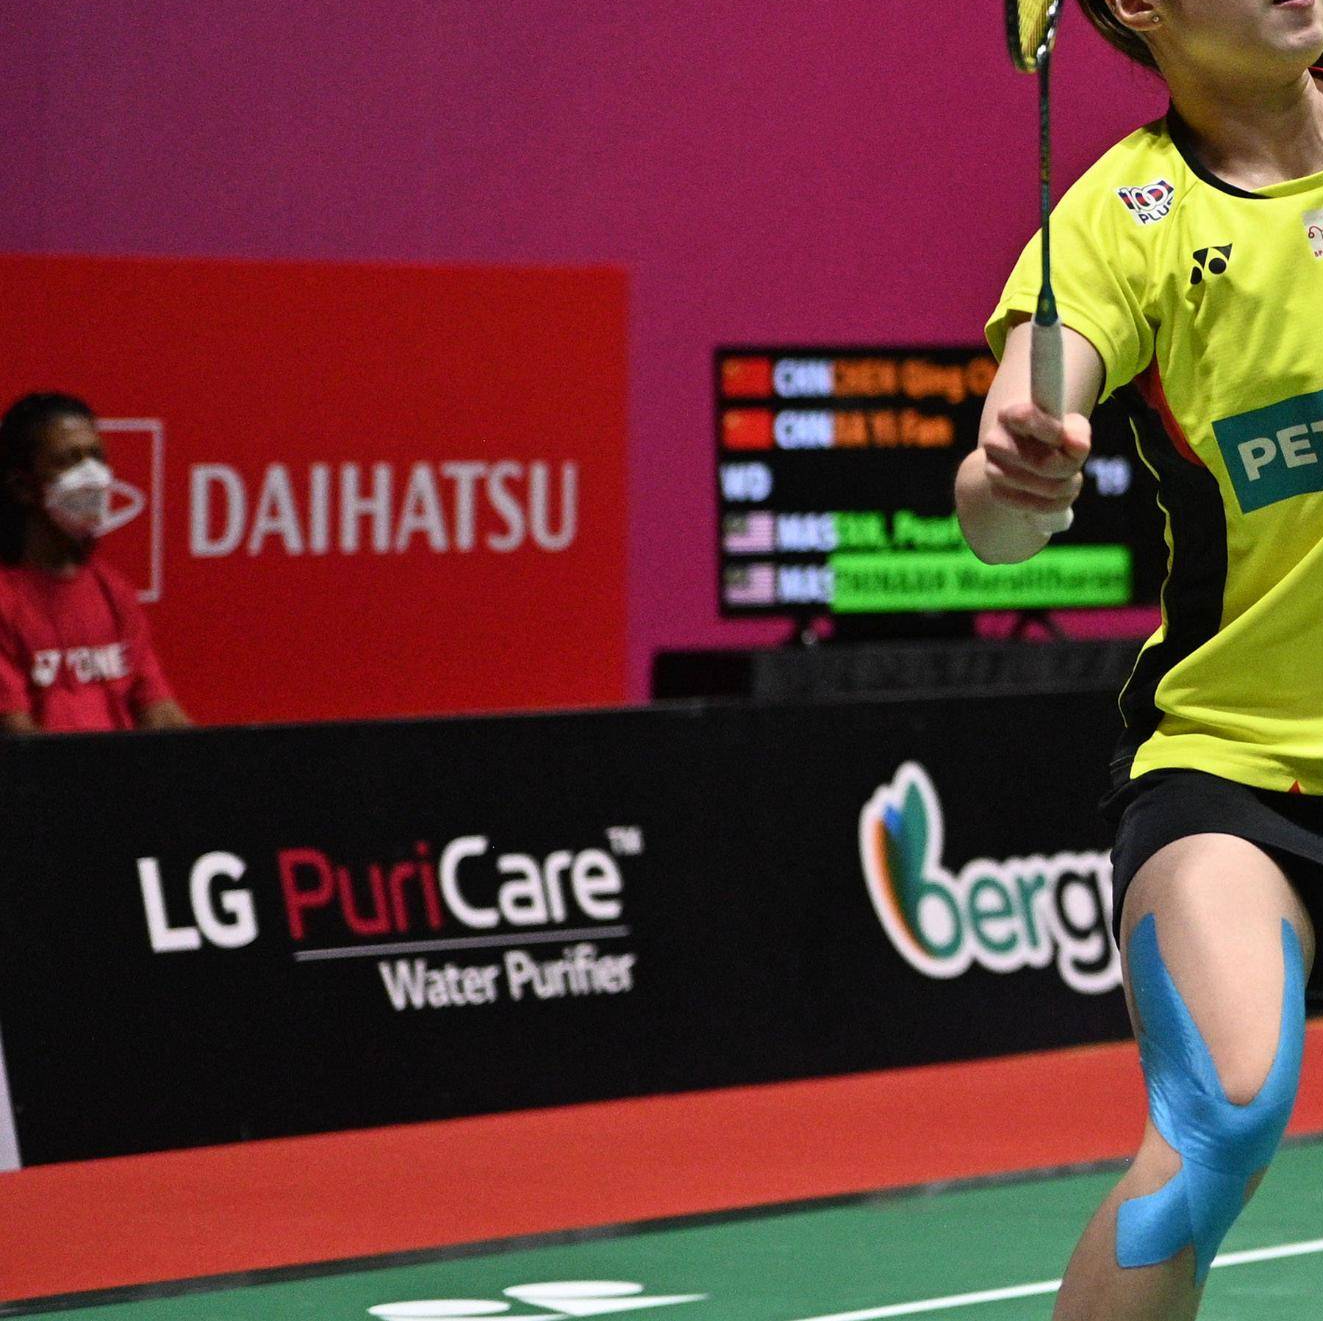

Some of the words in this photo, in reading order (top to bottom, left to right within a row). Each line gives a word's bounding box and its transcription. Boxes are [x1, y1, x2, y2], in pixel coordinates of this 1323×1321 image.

[189, 460, 578, 557] DAIHATSU
[136, 850, 259, 954] LG
[276, 834, 624, 941] PuriCare
[378, 958, 499, 1011] Water
[505, 941, 637, 1001] Purifier
